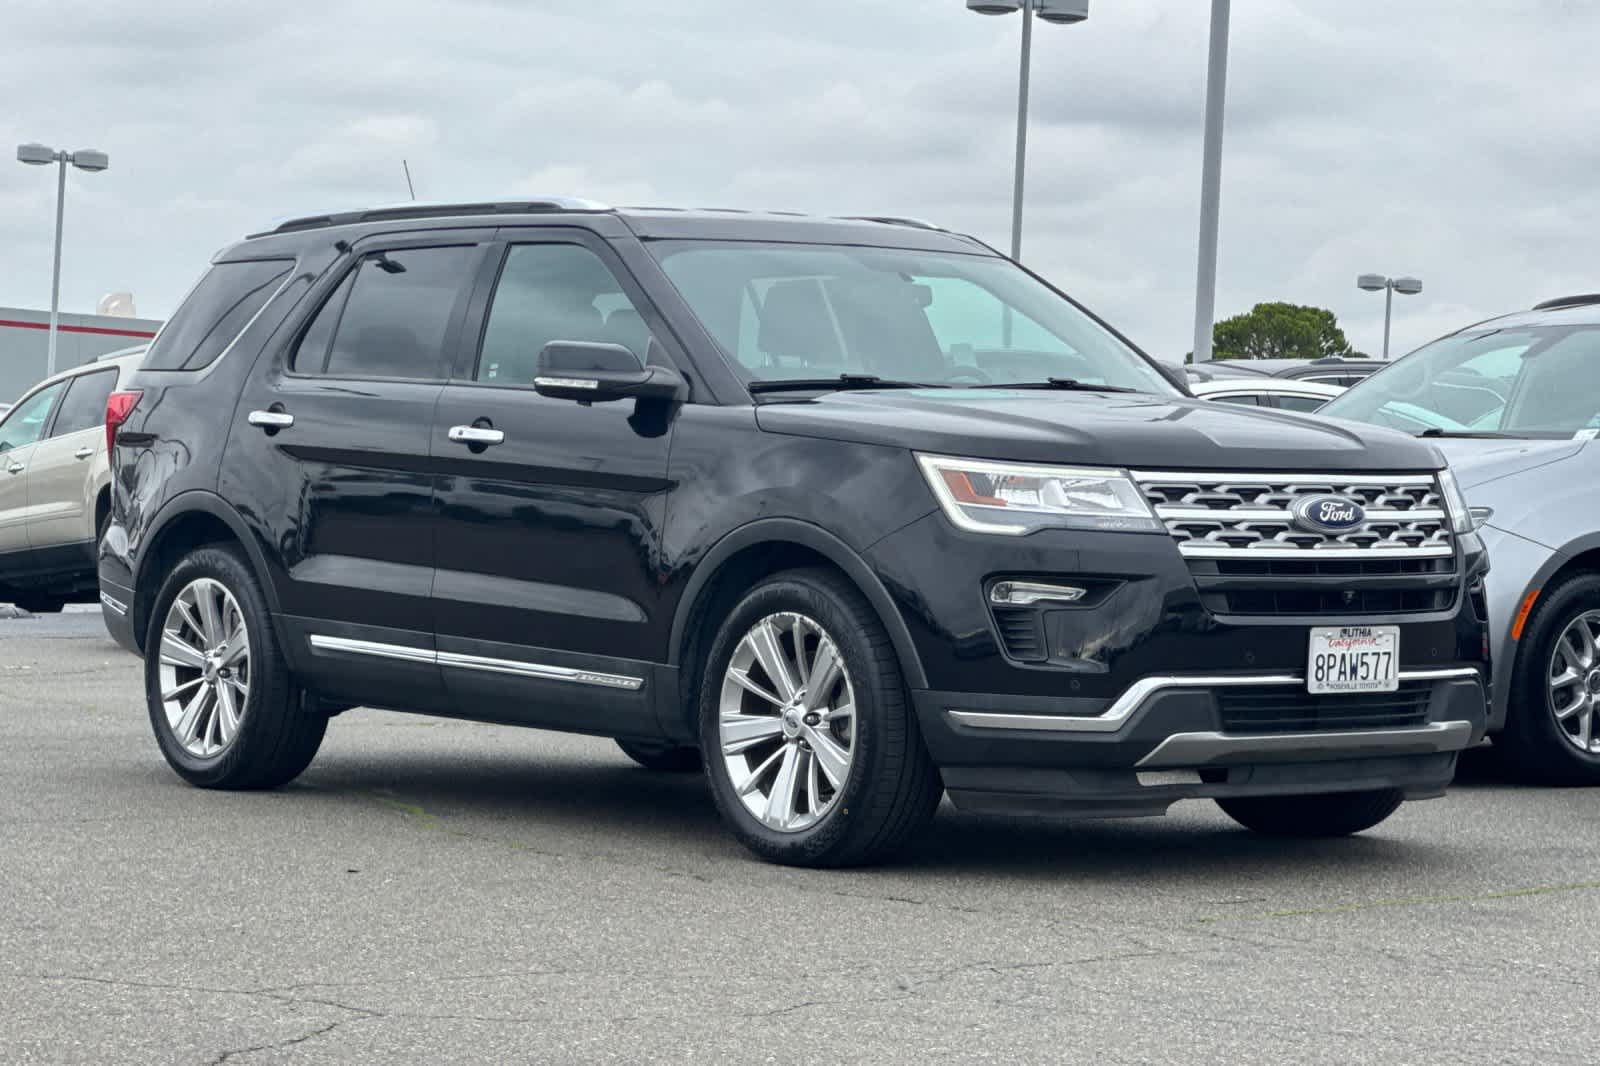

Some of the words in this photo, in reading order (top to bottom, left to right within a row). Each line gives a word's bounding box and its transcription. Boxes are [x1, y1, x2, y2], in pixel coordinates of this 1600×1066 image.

[1320, 501, 1355, 521] Ford
[1347, 628, 1372, 638] LITHIA
[1315, 652, 1391, 682] 8PAW577
